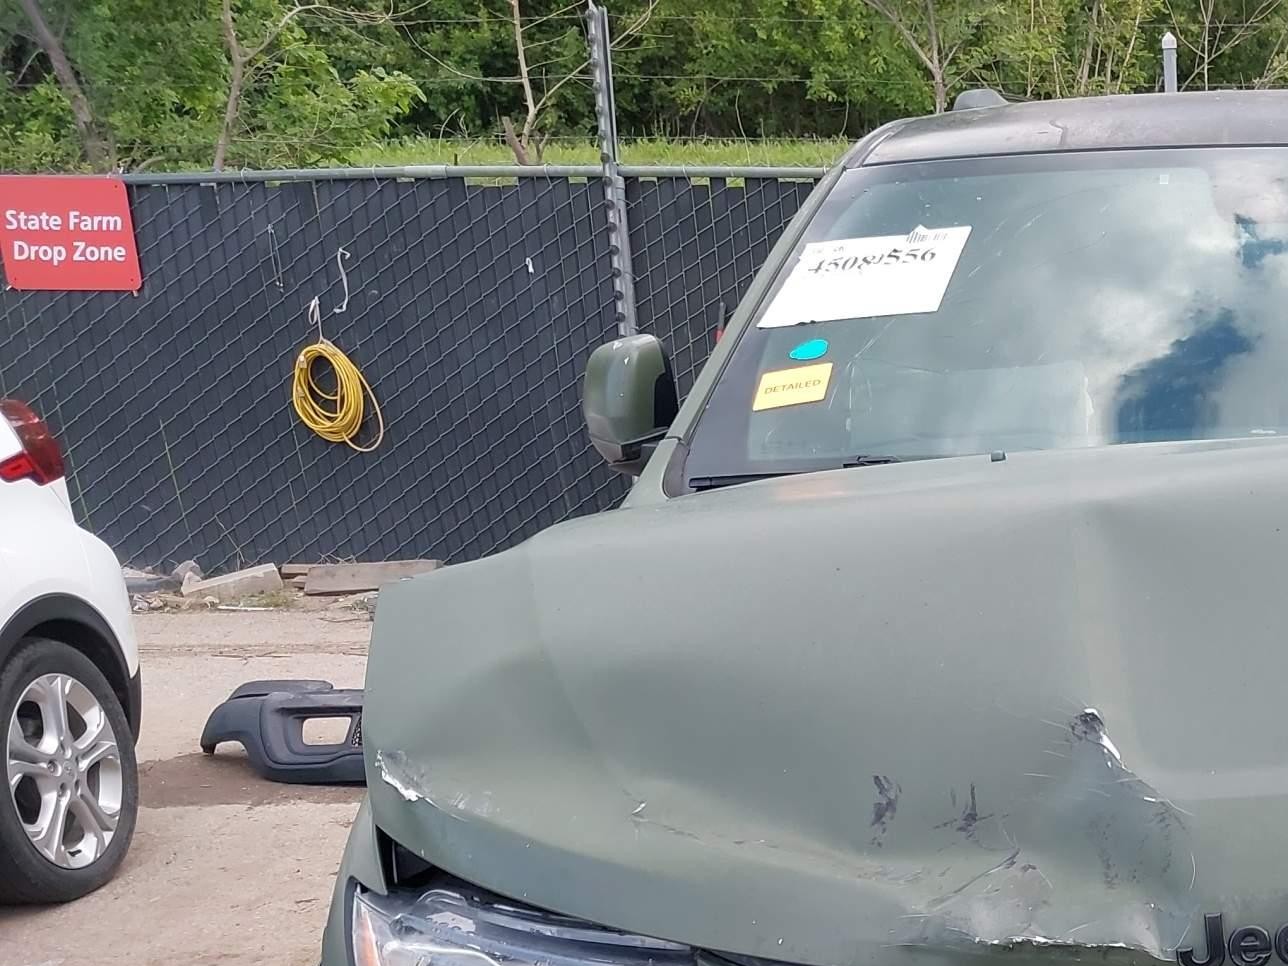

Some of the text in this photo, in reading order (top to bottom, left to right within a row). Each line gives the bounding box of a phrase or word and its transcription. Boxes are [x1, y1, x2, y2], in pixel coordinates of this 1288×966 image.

[5, 209, 122, 231] State Farm
[13, 240, 126, 266] Drop Zone
[764, 379, 821, 394] DETAILED
